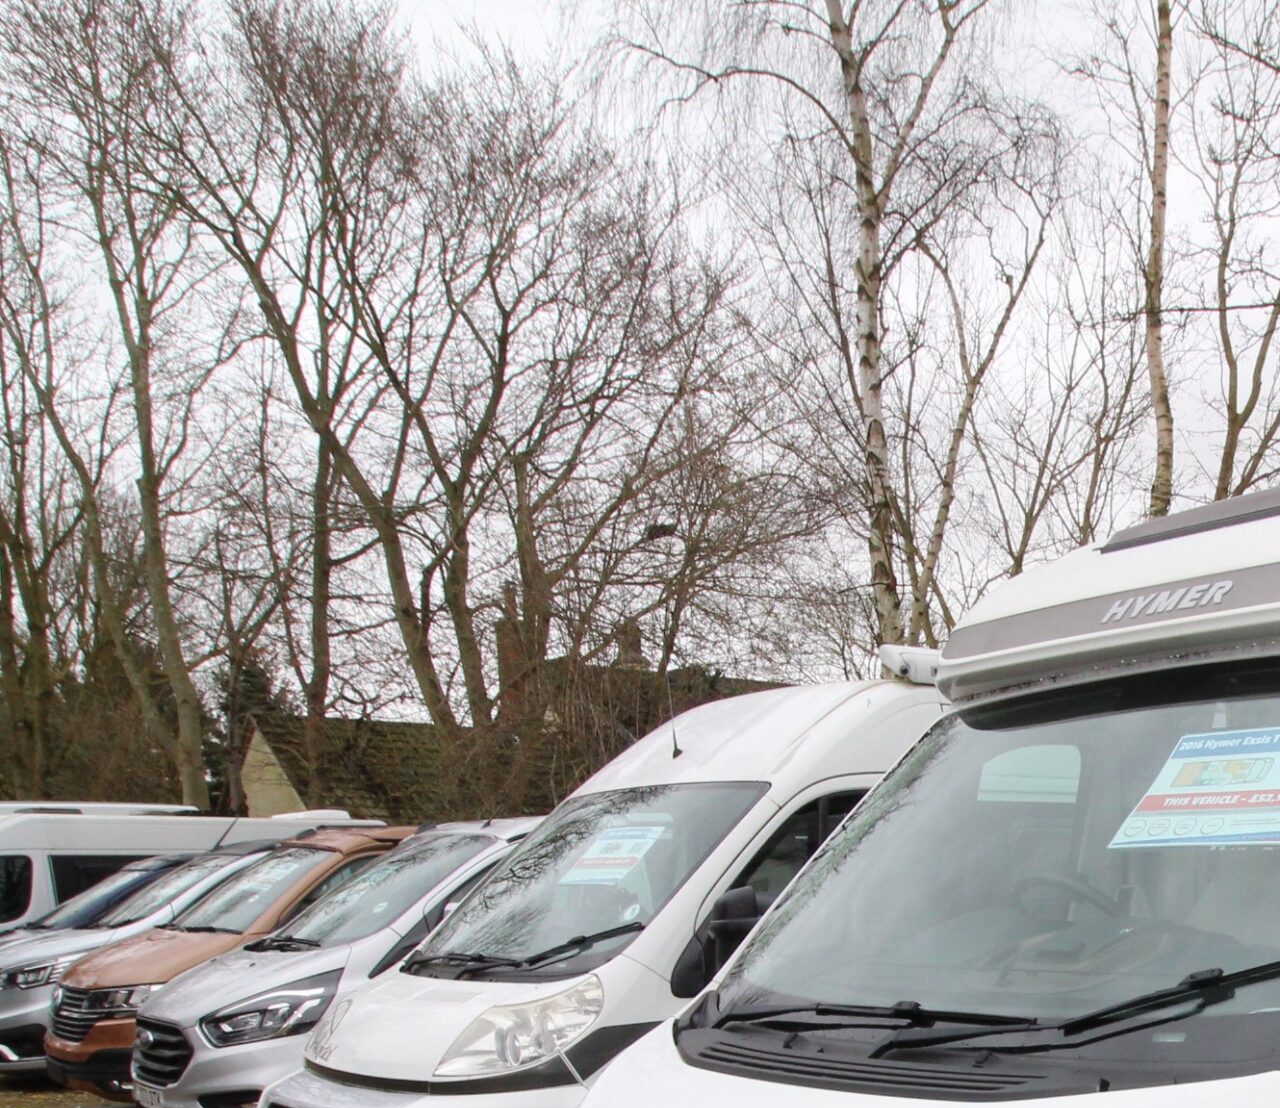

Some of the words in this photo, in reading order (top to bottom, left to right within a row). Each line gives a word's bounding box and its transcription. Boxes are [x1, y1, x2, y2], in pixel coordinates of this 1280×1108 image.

[1101, 580, 1233, 624] HYMER
[1179, 740, 1202, 751] 2016
[1204, 738, 1240, 750] Hymer
[1242, 735, 1271, 746] Exsis
[1163, 797, 1189, 806] THIS
[1191, 795, 1239, 805] VEHICLE
